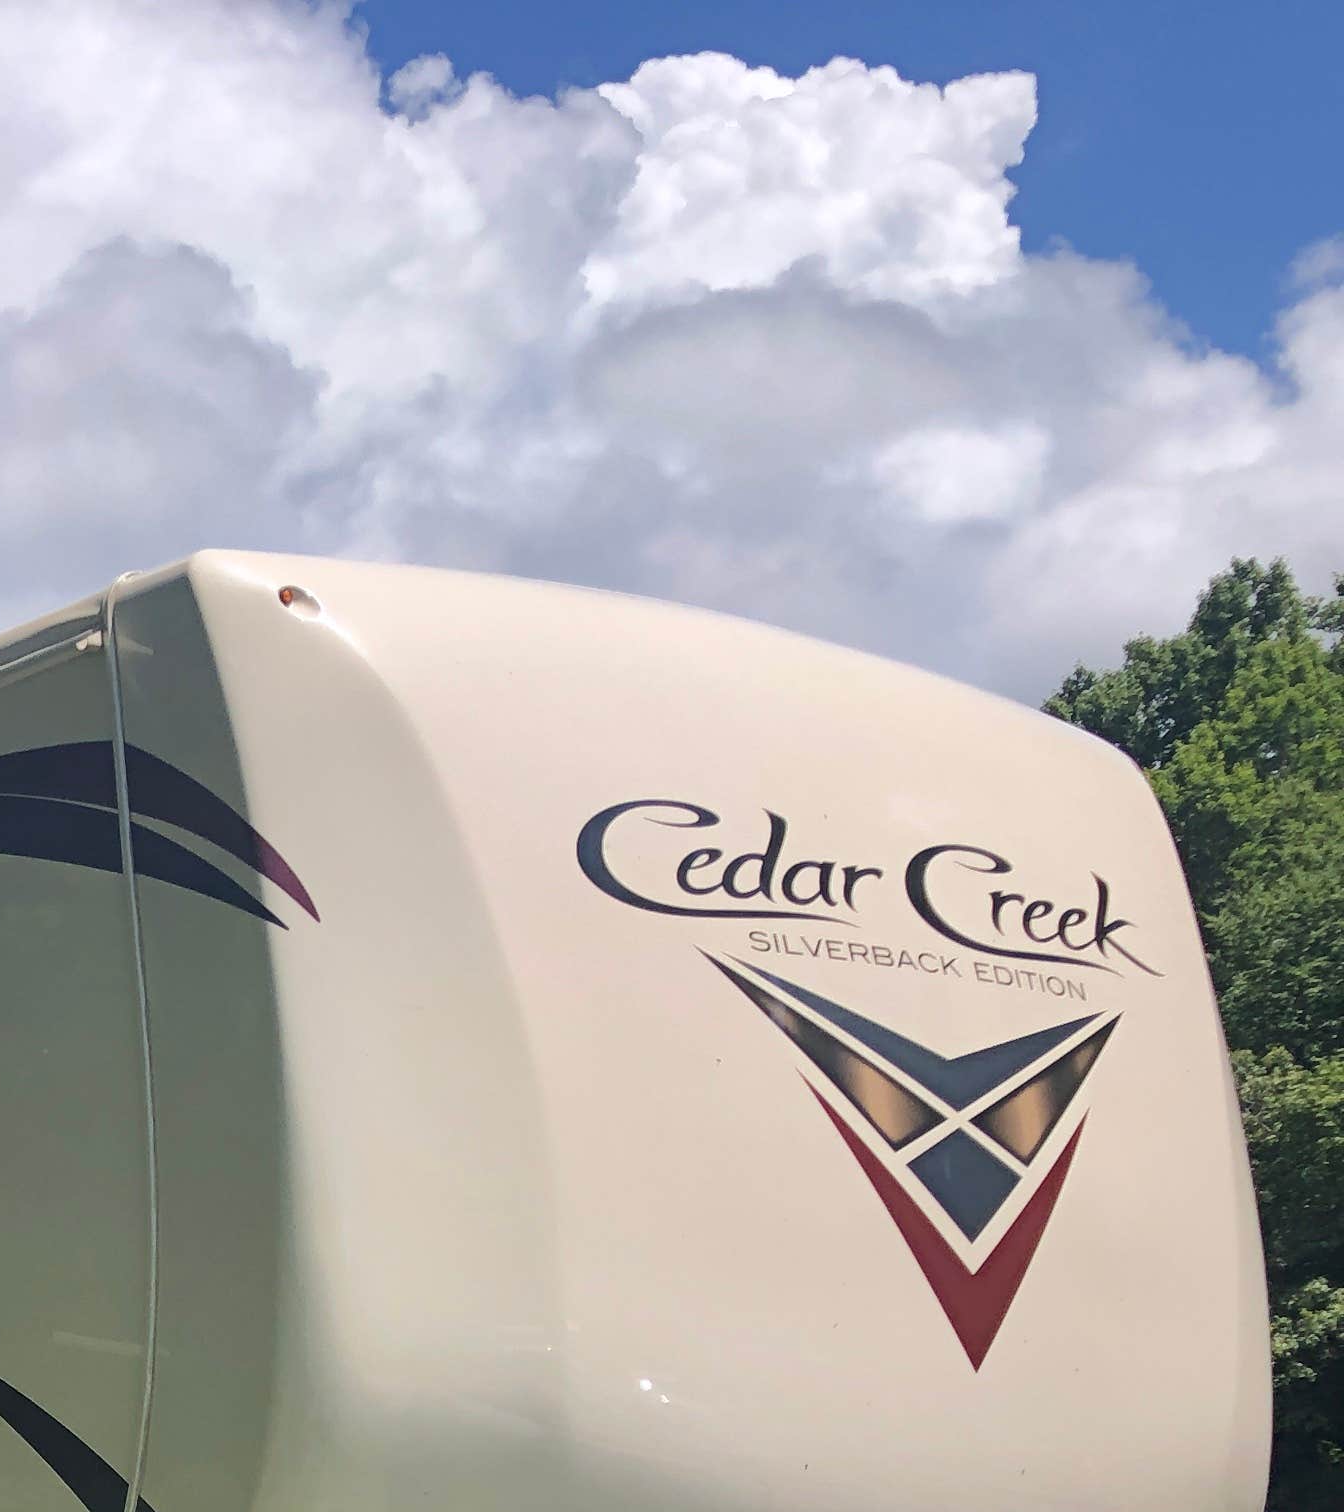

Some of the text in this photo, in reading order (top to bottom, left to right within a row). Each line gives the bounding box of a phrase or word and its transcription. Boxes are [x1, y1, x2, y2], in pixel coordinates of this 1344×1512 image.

[576, 800, 1167, 977] Cedar Creek
[747, 930, 1087, 1002] SILVERBACK EDITION
